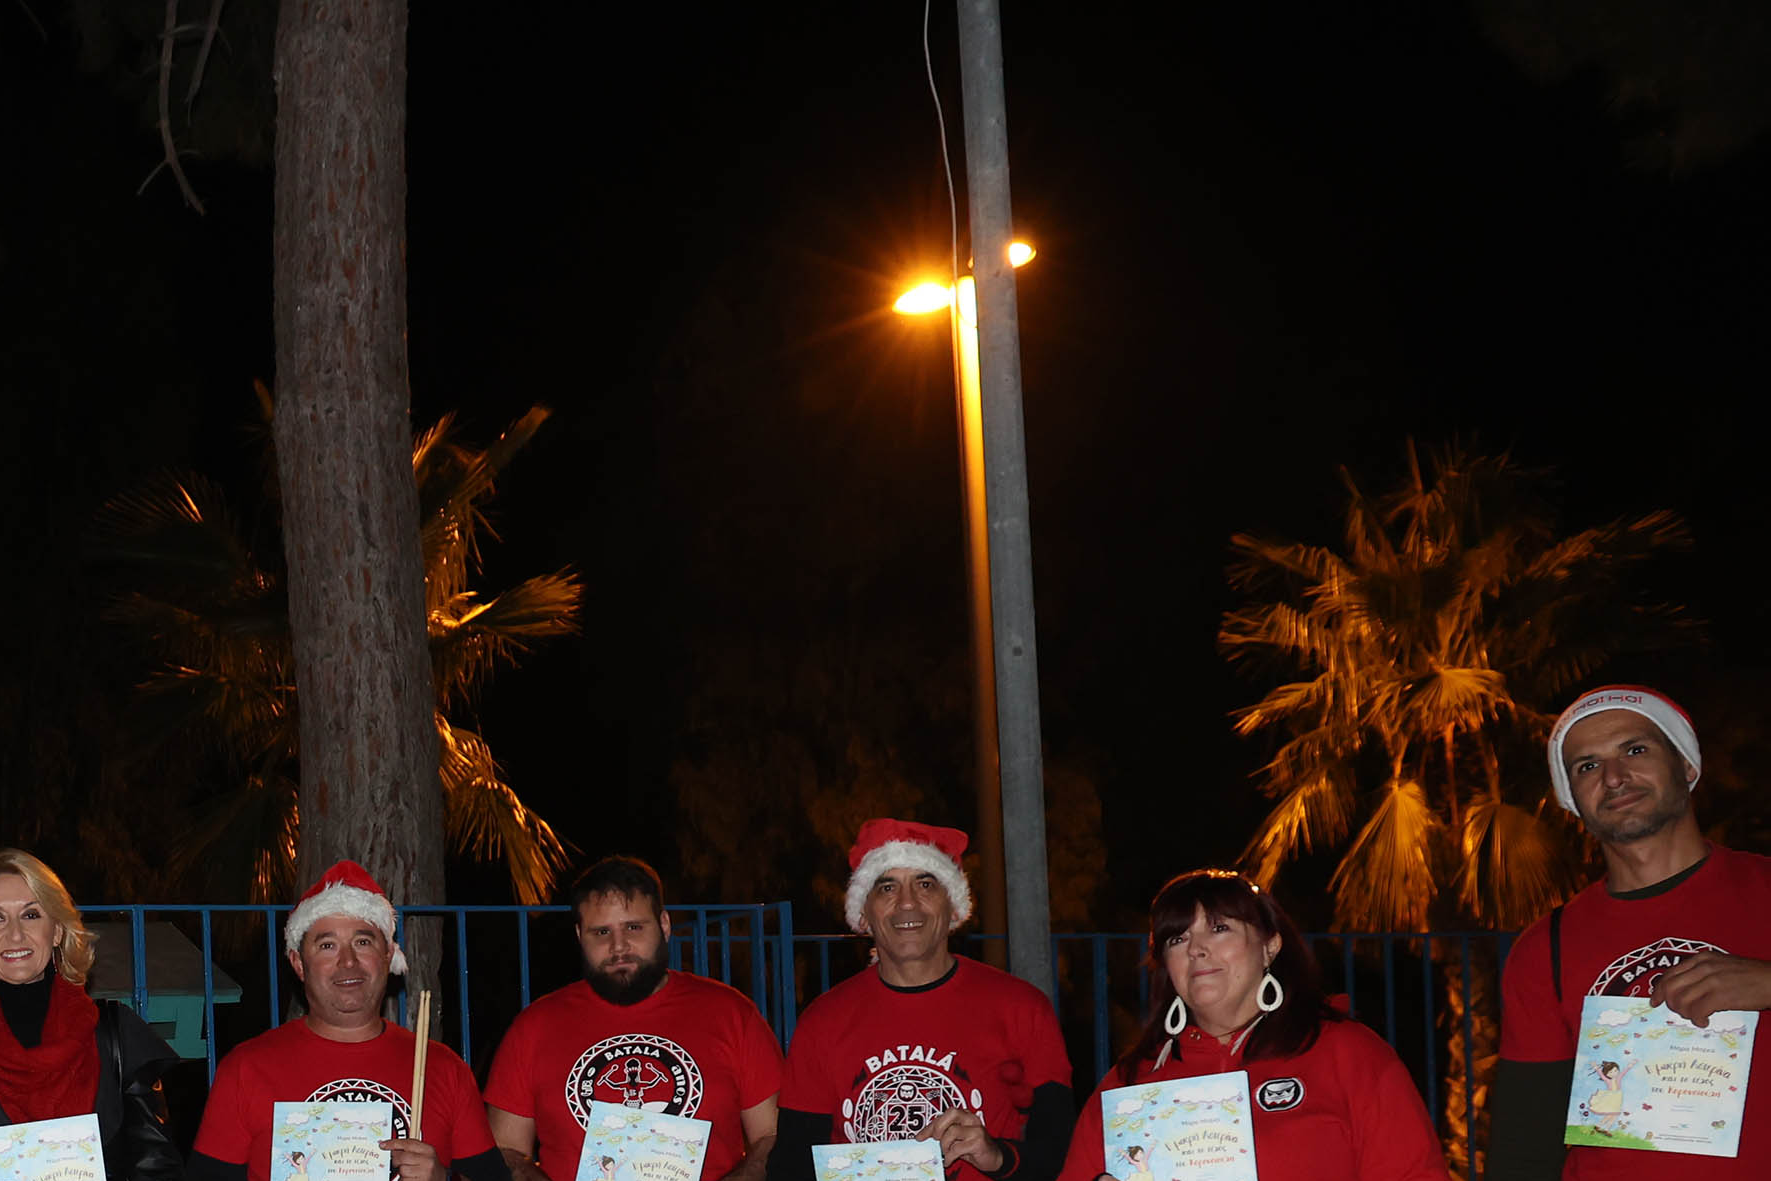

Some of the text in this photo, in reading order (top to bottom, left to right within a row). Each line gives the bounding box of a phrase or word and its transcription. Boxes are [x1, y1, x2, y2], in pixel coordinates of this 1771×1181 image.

[603, 1045, 661, 1062] BATALA
[864, 1044, 958, 1073] BATALÁ
[671, 1064, 687, 1106] anos
[888, 1105, 925, 1132] 25
